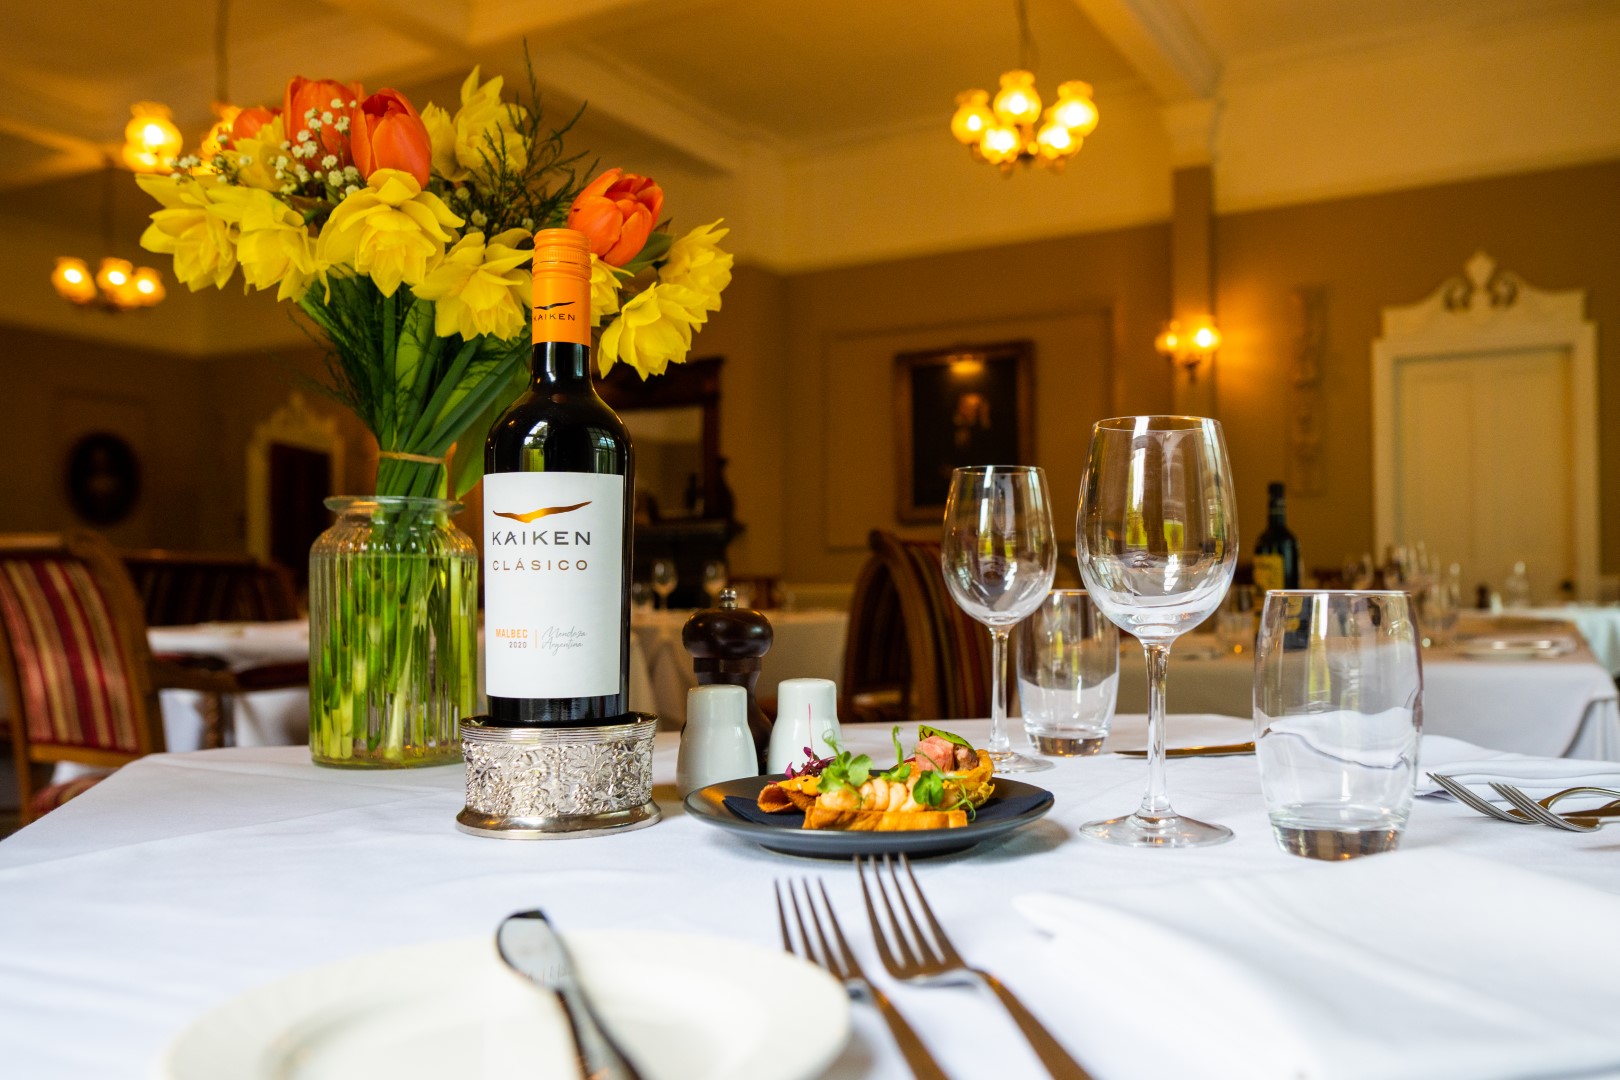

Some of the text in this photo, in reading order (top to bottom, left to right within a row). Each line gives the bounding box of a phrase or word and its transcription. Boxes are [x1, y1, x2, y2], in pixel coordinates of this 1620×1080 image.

[492, 530, 591, 546] KAIKEN
[492, 557, 588, 571] CLÁSICO
[495, 628, 528, 639] MALBEC
[541, 626, 587, 639] Mendoza
[508, 641, 527, 649] 2020
[541, 637, 584, 656] Argentina
